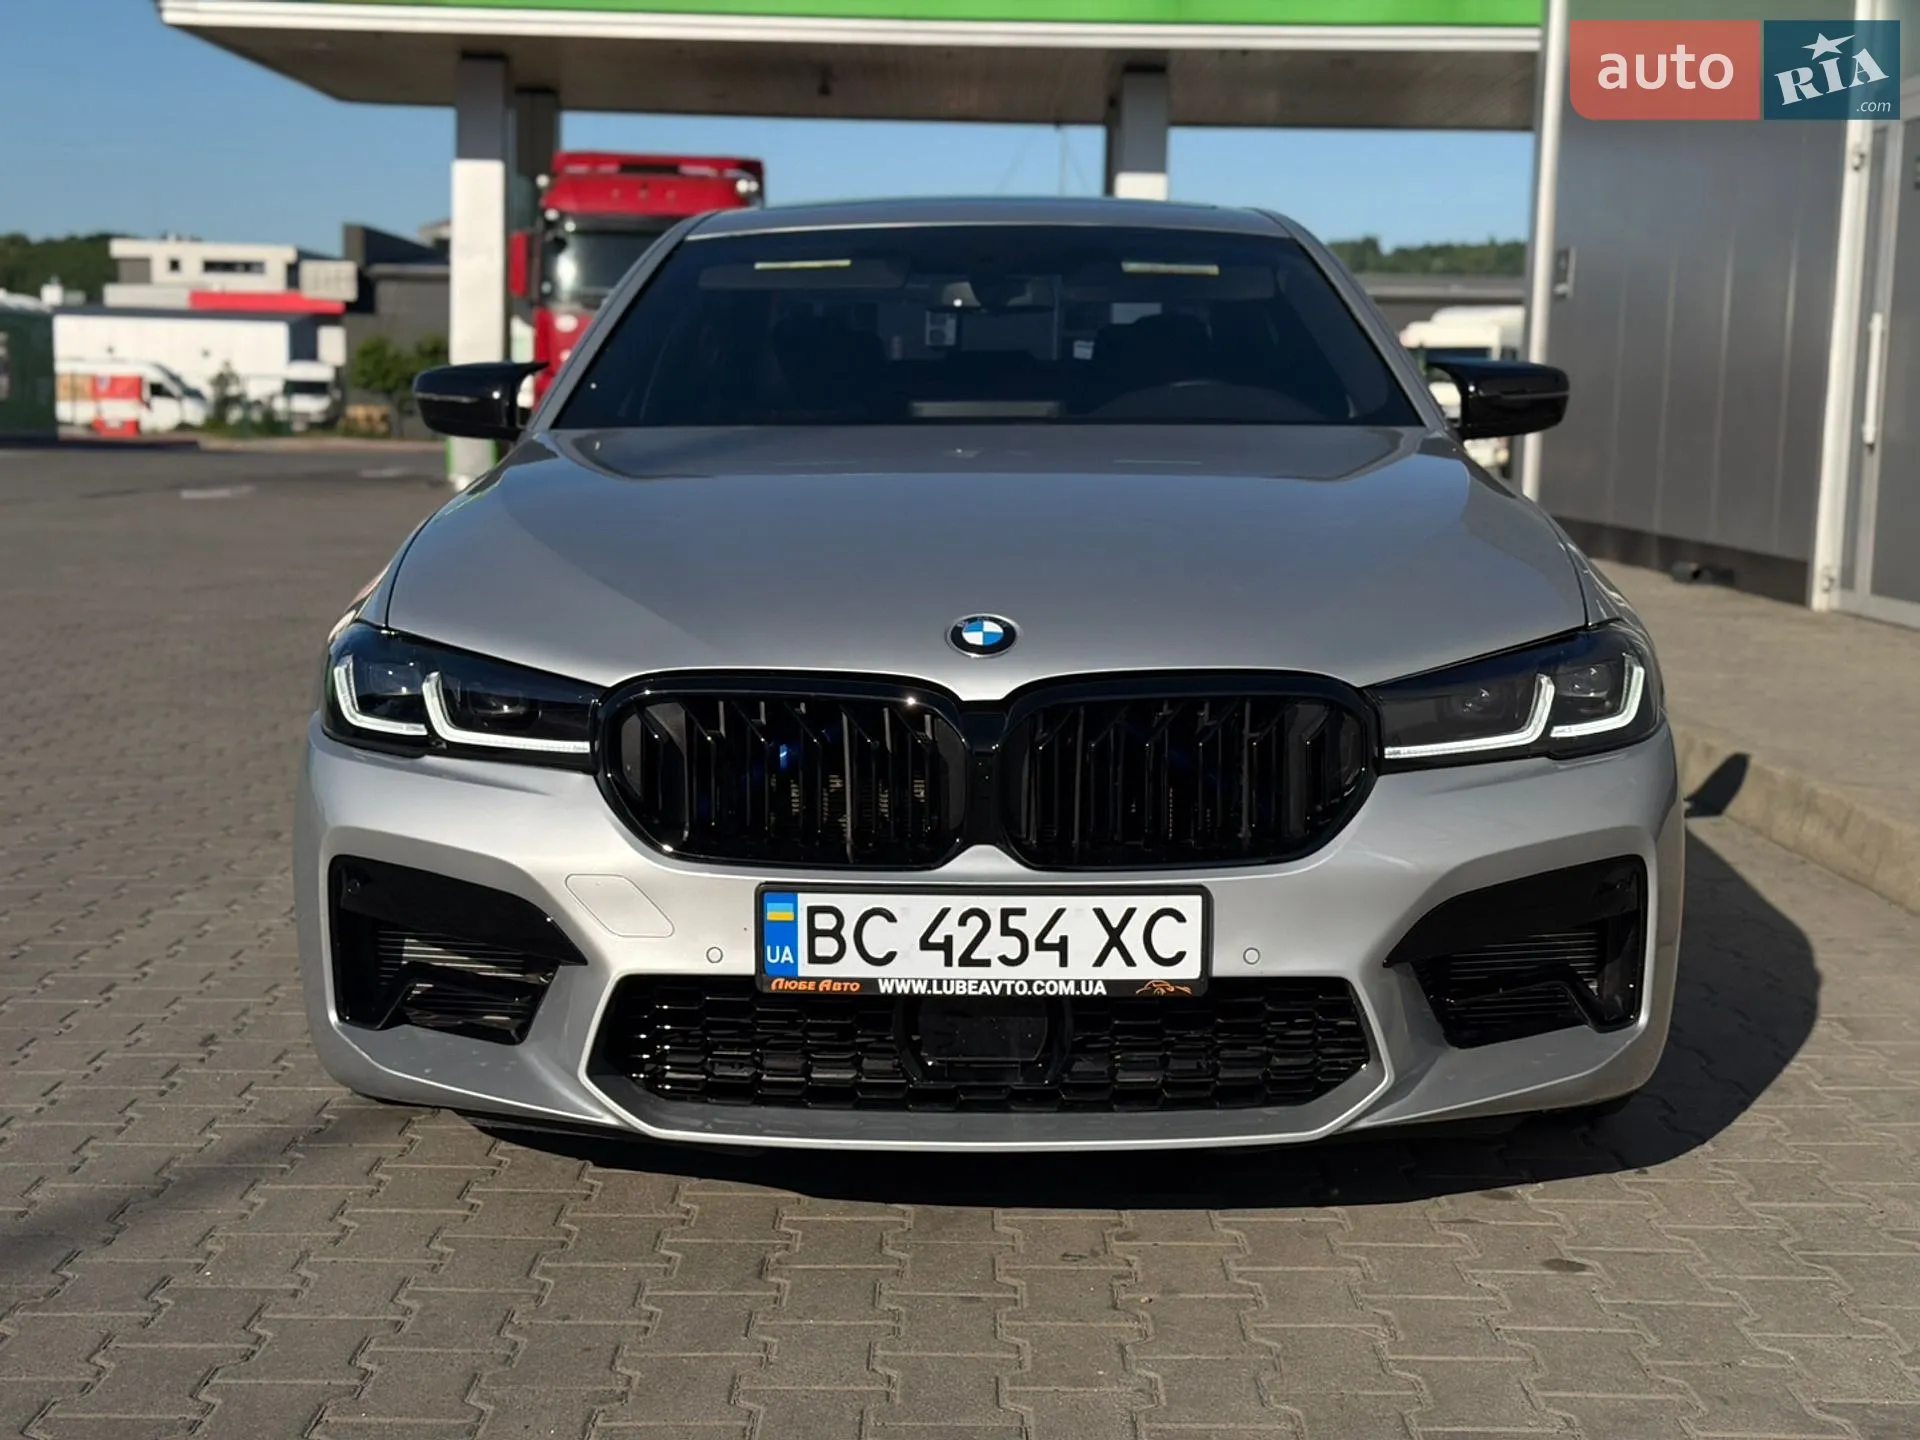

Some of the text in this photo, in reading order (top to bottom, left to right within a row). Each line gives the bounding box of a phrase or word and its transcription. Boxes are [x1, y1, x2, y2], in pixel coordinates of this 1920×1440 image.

[805, 905, 1187, 968] BC 4254 XC
[766, 946, 795, 964] UA
[877, 978, 1107, 996] WWW.LUBEAVTO.COM.UA
